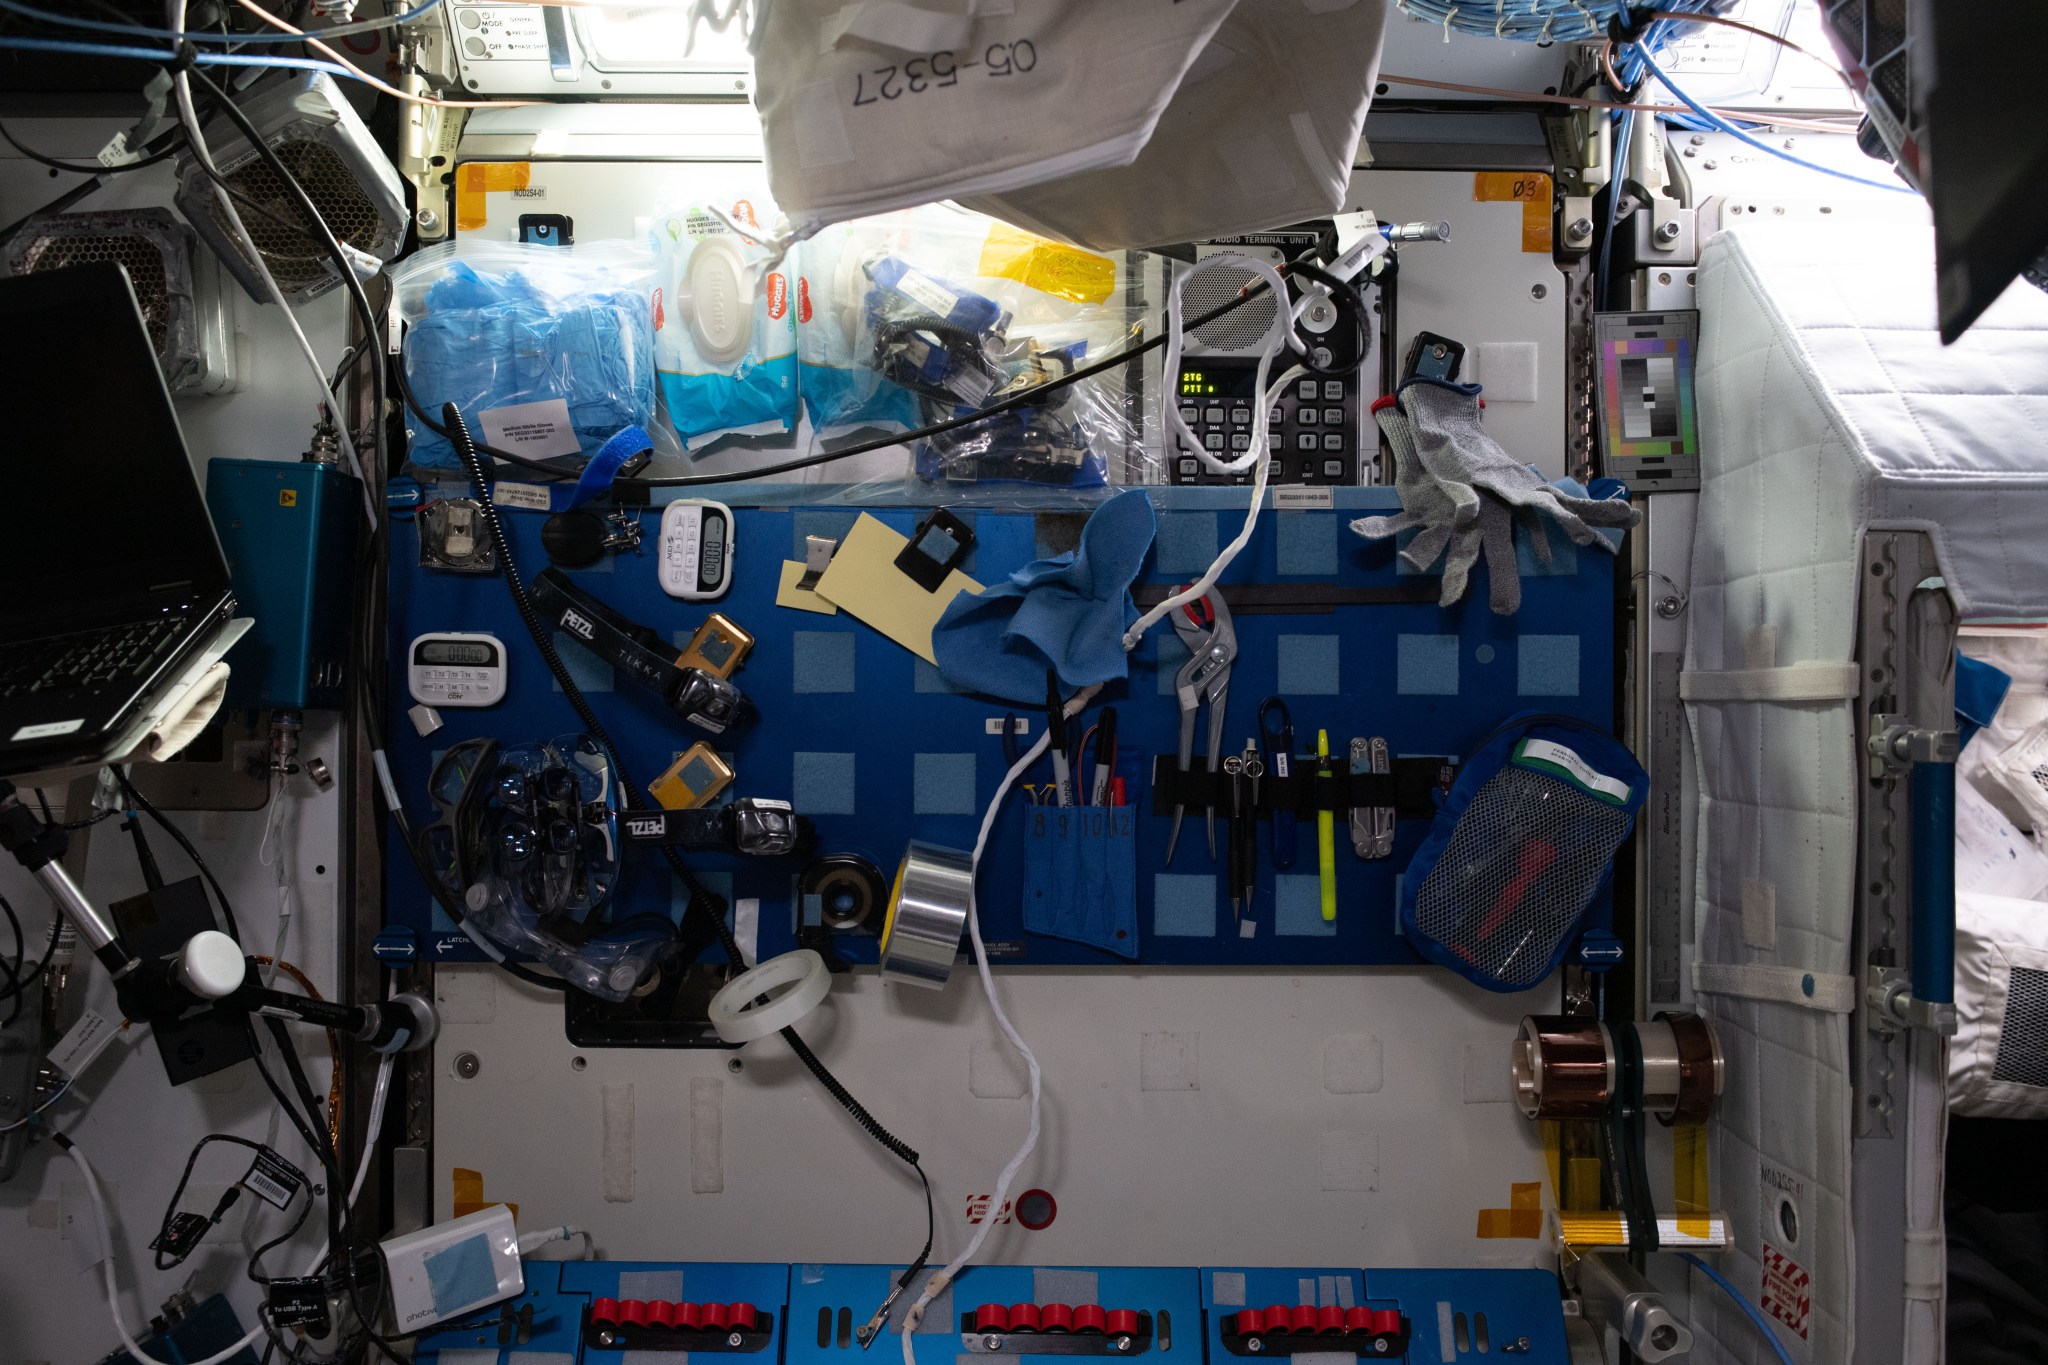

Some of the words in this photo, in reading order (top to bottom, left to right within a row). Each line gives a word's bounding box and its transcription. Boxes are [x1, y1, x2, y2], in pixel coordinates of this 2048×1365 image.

[1245, 236, 1285, 244] TERMINAL
[1290, 236, 1308, 244] UNIT
[771, 277, 784, 317] HUGGIES
[1184, 373, 1202, 382] 2TG
[1184, 385, 1201, 393] PTT
[560, 609, 594, 640] PETZL
[618, 649, 661, 679] TIKKA
[1062, 777, 1075, 808] harpie
[626, 813, 666, 836] PETZL
[1058, 814, 1068, 838] 9
[1084, 813, 1102, 838] 10
[1768, 1279, 1781, 1294] FIRE
[1782, 1287, 1796, 1305] PORT
